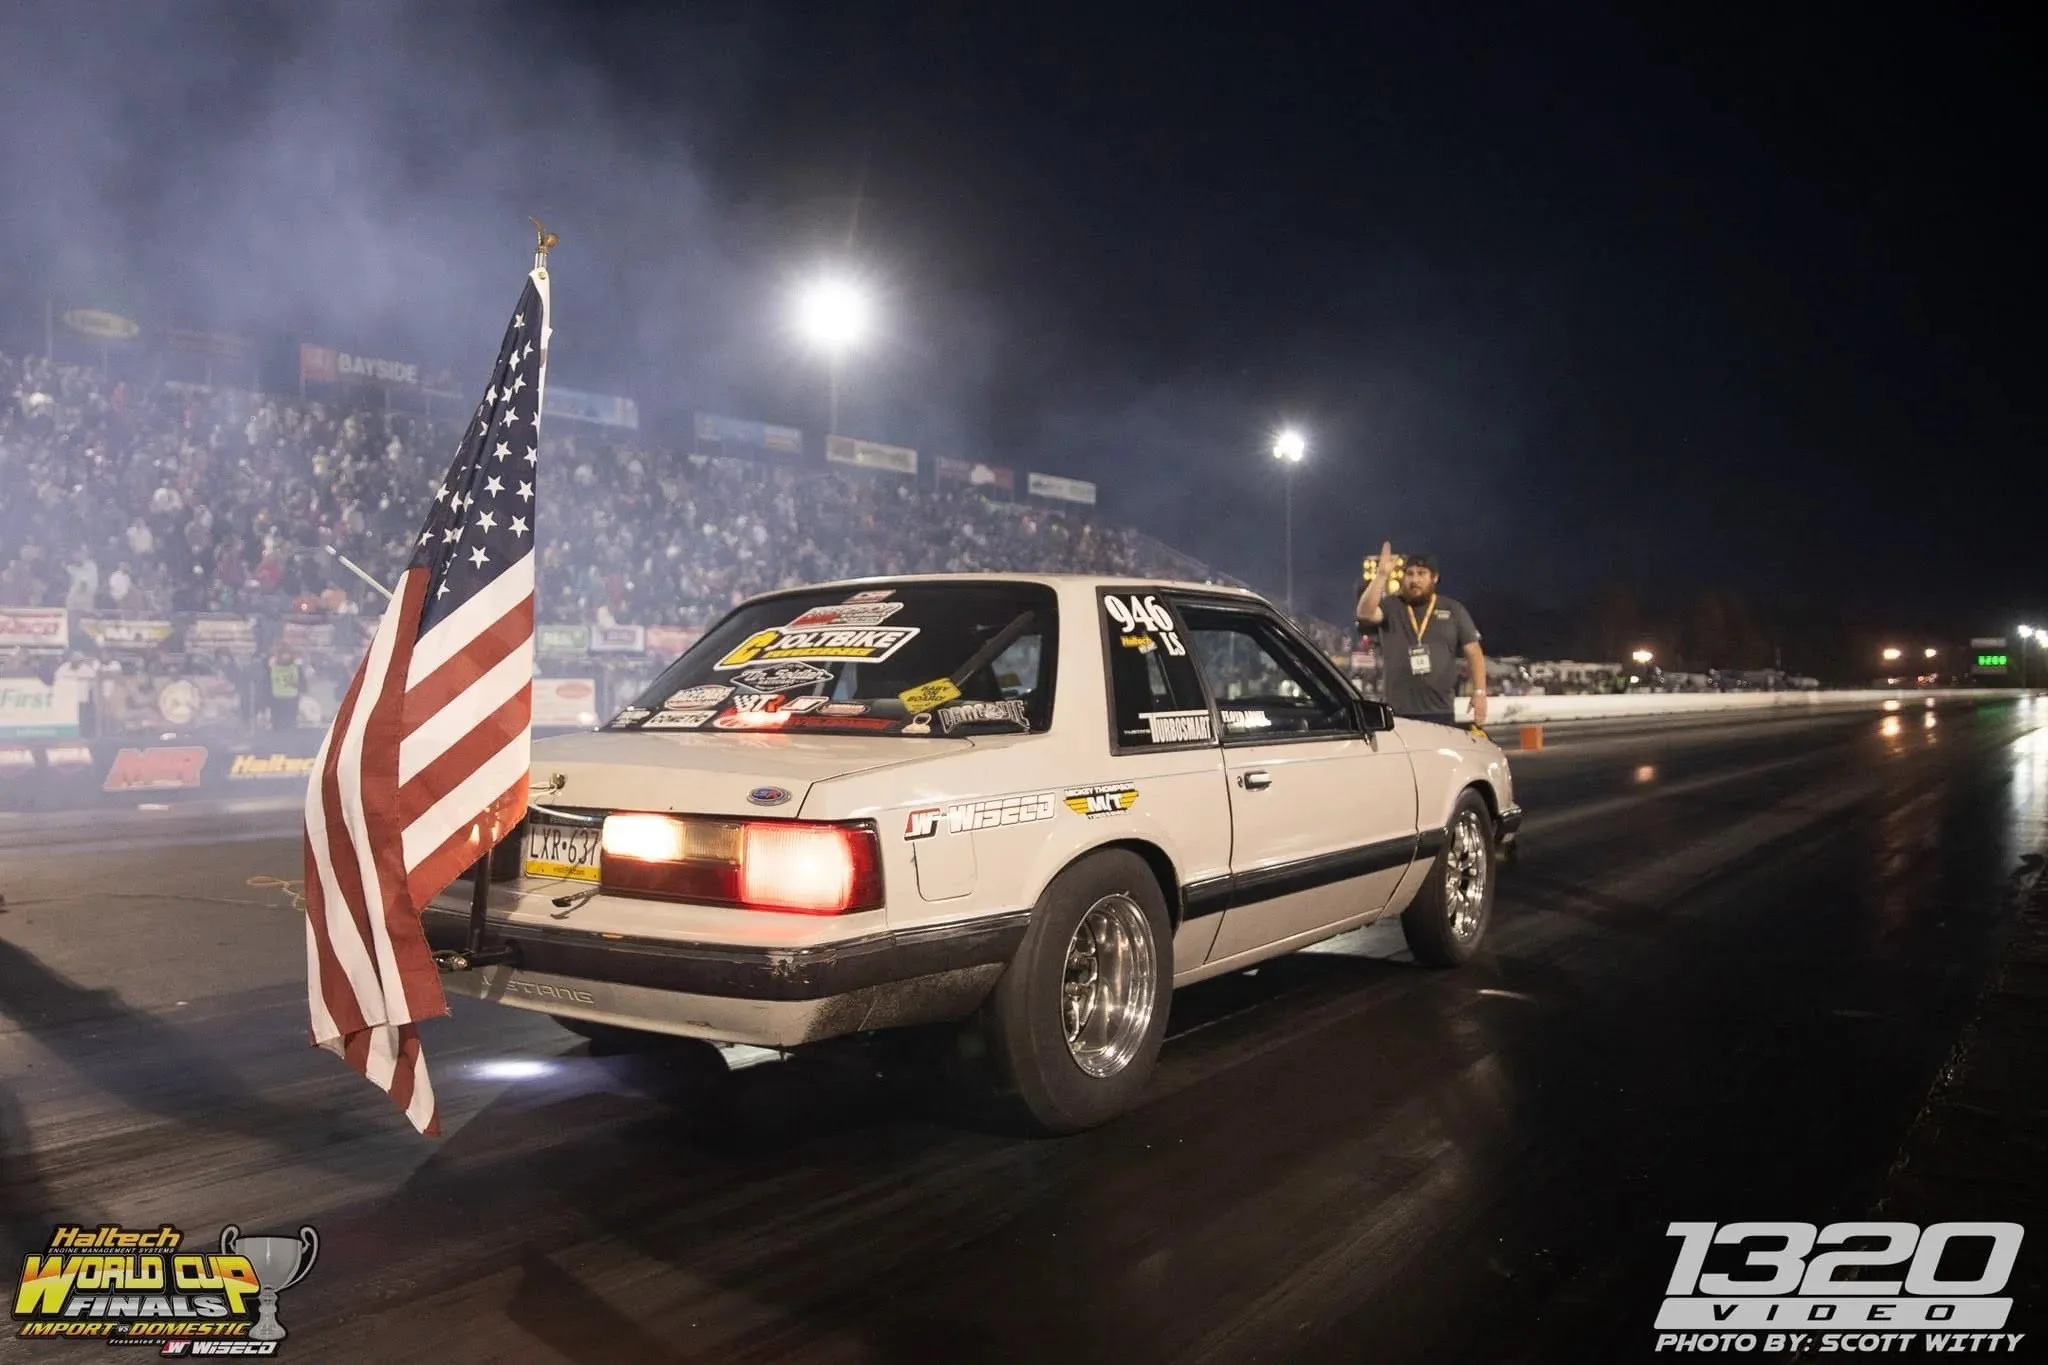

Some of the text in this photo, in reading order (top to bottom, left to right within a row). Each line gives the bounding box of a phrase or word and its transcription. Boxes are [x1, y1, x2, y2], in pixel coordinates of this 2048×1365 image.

[338, 352, 418, 384] BAYSIDE
[1103, 594, 1174, 633] 946
[1159, 632, 1186, 656] LS
[1138, 709, 1212, 744] TURBOSMART
